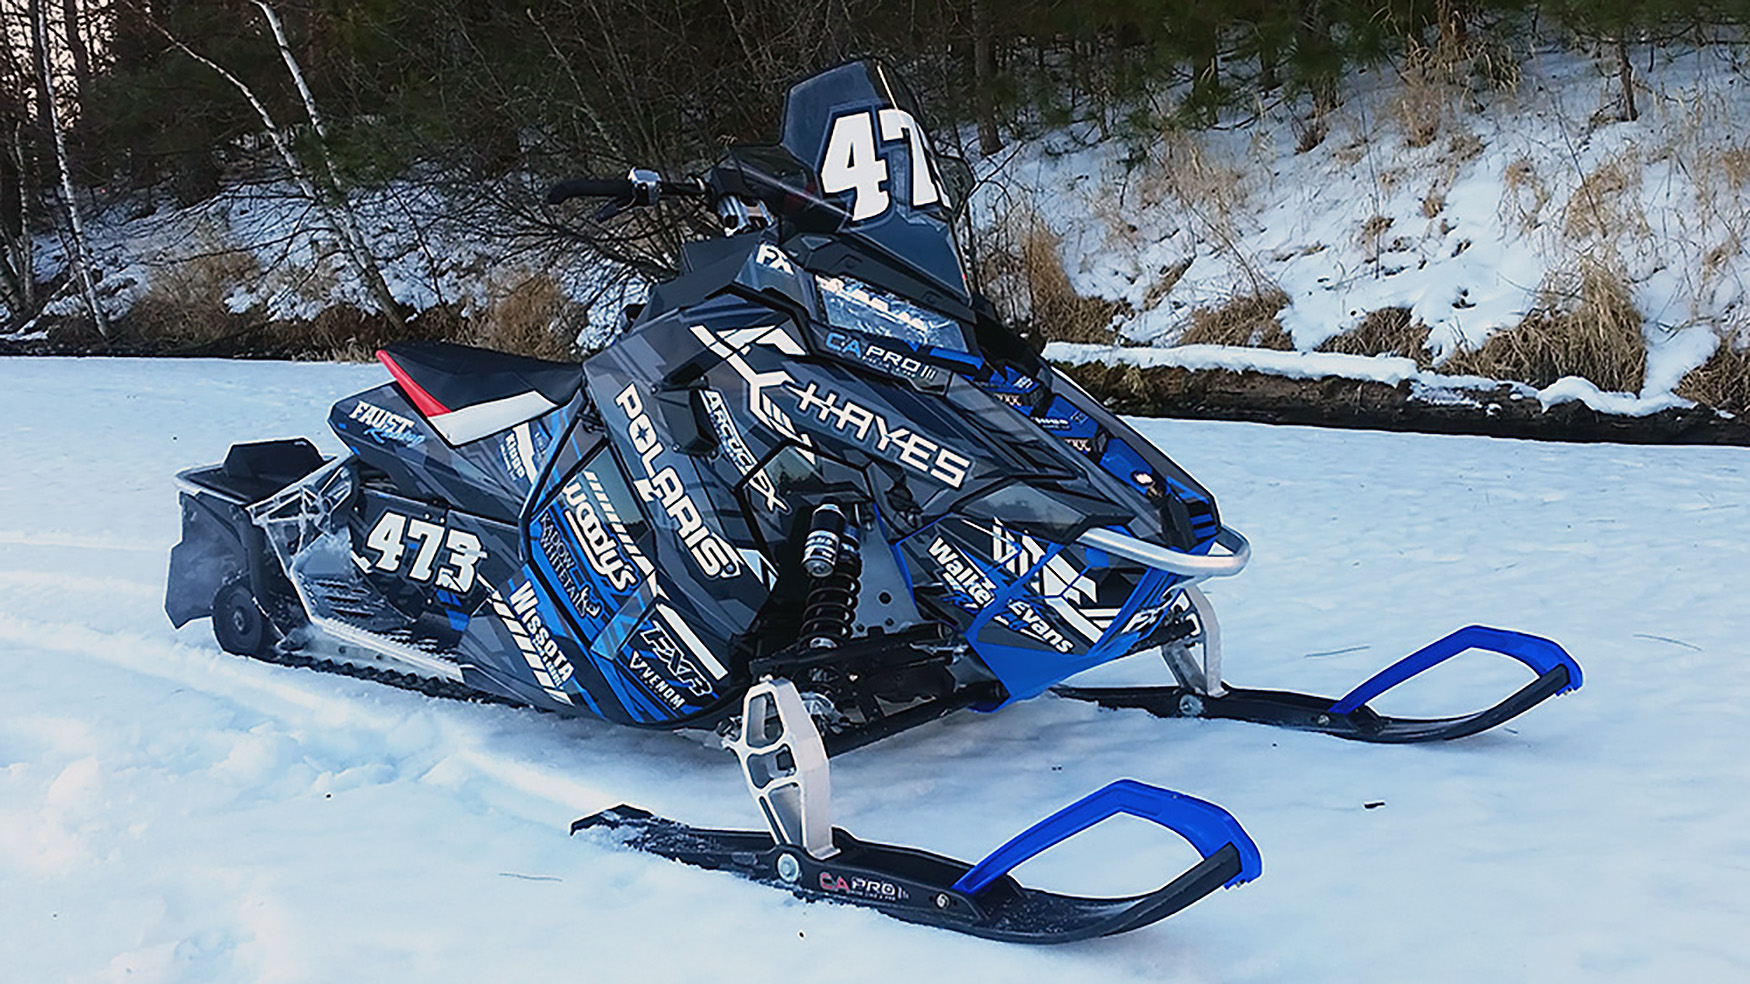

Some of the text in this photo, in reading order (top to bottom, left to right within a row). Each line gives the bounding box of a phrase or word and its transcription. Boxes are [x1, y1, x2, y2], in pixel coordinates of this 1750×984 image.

[756, 243, 795, 275] FX
[349, 400, 415, 434] FAUST
[782, 382, 971, 488] HAYES
[616, 383, 730, 577] POLARIS
[366, 511, 483, 593] 473
[540, 512, 575, 568] KADOW
[541, 535, 586, 618] WHITETAILS
[640, 620, 712, 697] FXR
[1008, 599, 1074, 654] Evans
[641, 667, 686, 709] VENOM
